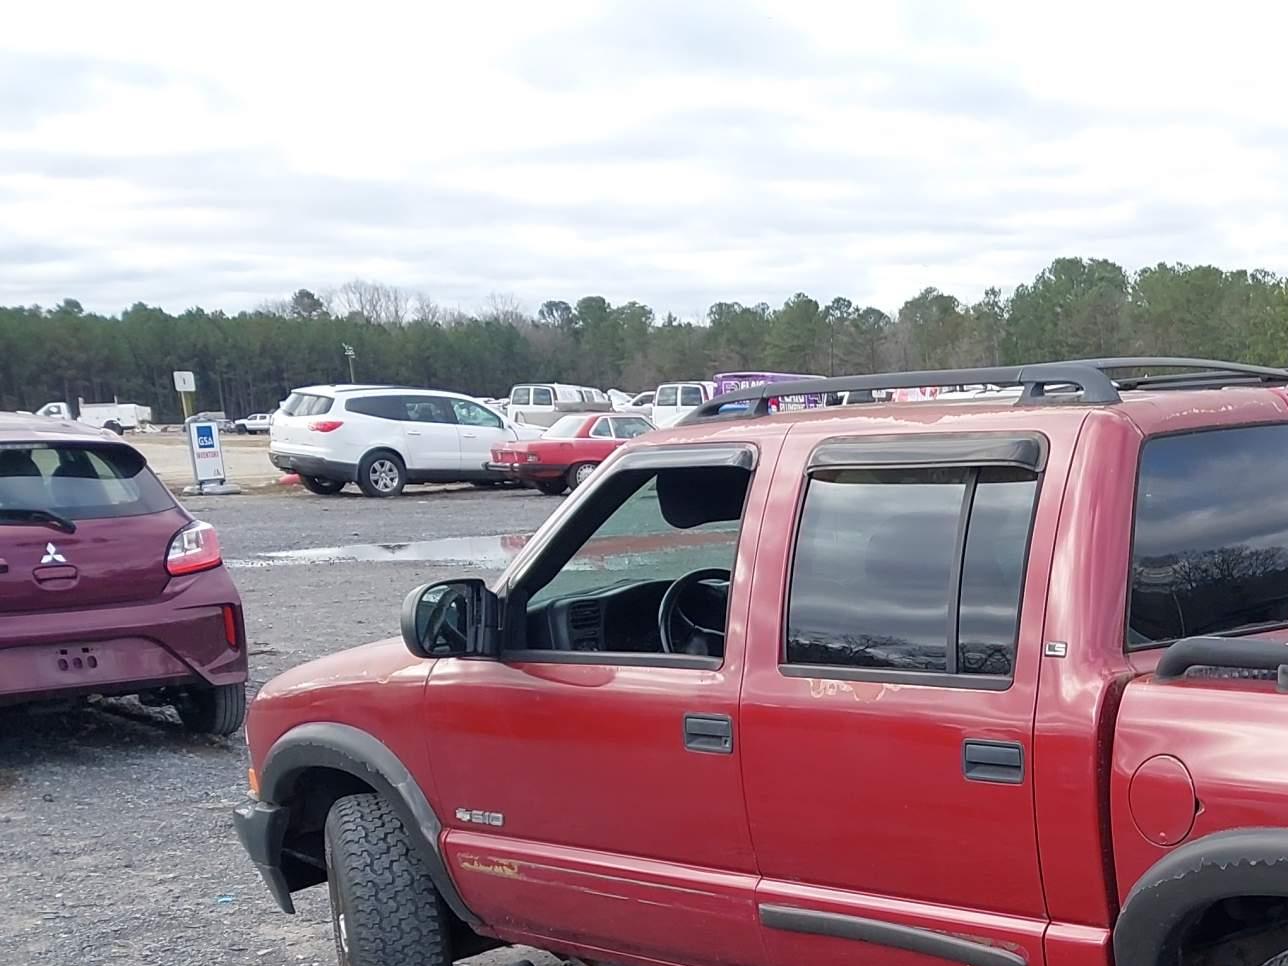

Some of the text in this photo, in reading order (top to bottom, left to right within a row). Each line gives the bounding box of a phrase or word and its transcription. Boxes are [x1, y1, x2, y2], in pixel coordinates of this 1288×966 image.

[198, 436, 213, 447] GSA
[1045, 642, 1066, 656] LS
[471, 810, 504, 827] S10
